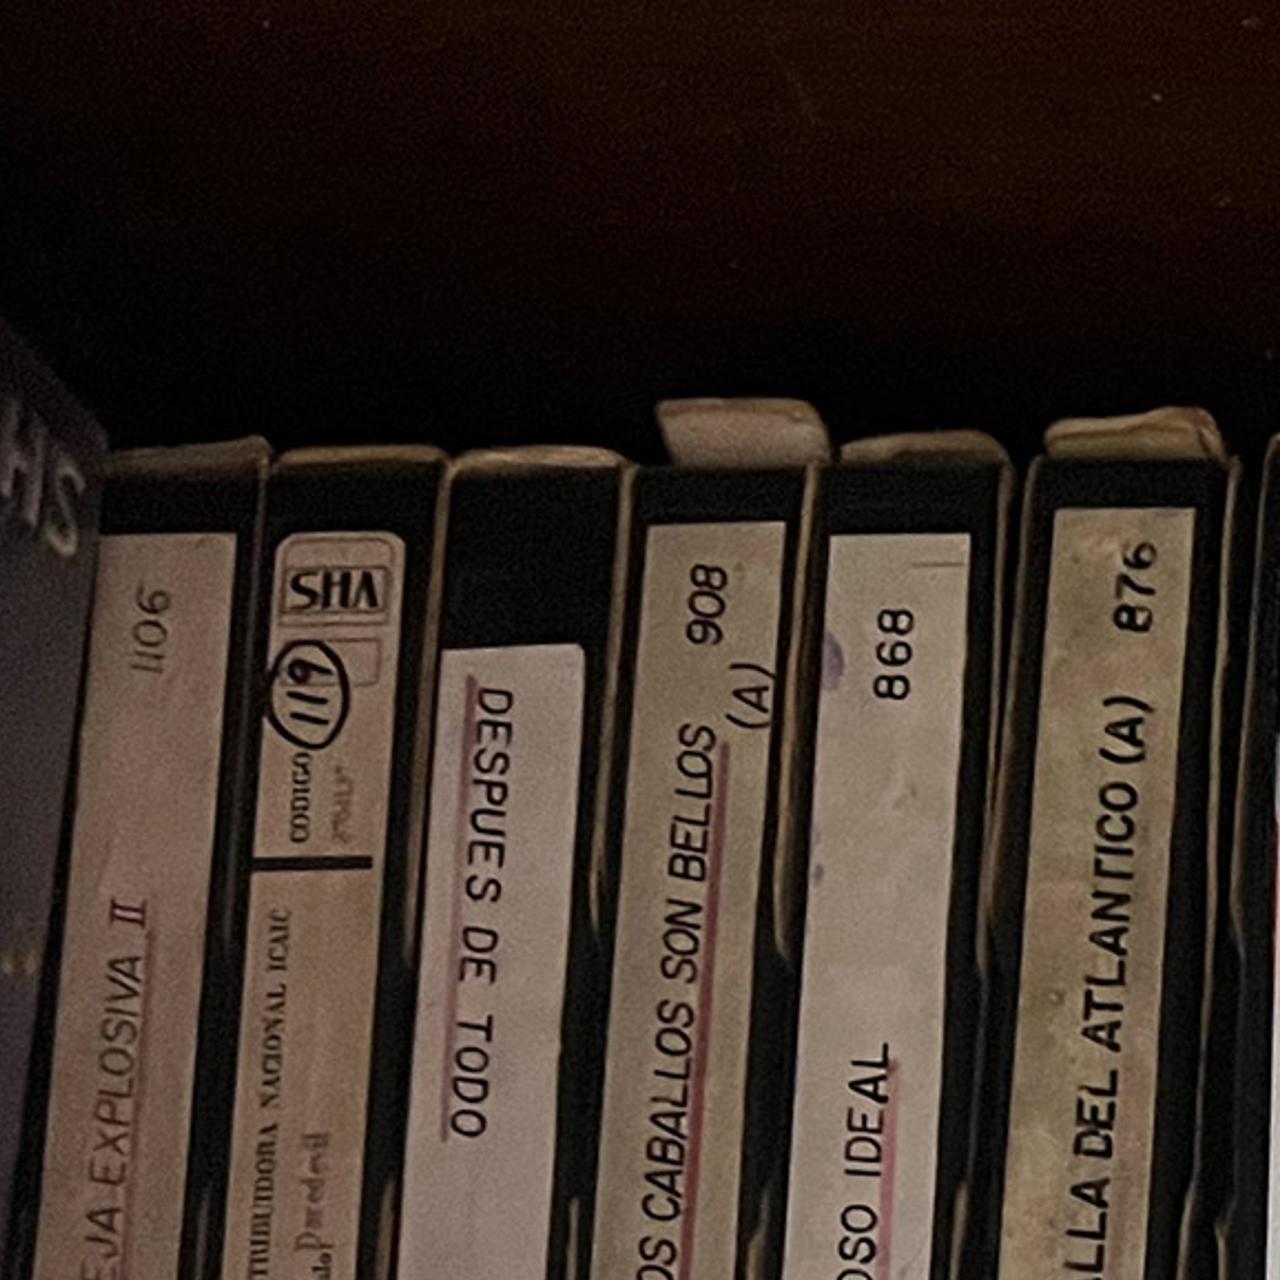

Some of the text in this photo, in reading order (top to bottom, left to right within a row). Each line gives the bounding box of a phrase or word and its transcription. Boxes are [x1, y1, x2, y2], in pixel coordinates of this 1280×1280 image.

[128, 587, 170, 676] 1106
[289, 569, 381, 610] VHS
[687, 563, 729, 646] 908
[1112, 541, 1158, 633] 876
[725, 662, 777, 730] (A)
[873, 607, 915, 701] 868
[1099, 695, 1157, 764] (A)
[289, 752, 313, 844] CODIGO
[668, 722, 718, 882] BELLOS
[265, 906, 295, 973] ICAIC
[449, 686, 515, 1140] DESPUES DE TODO
[660, 900, 704, 984] SON
[1080, 781, 1140, 1053] ATLANTICO
[89, 955, 142, 1187] EXPLOSIVA
[260, 980, 287, 1110] NACIONAL
[641, 999, 695, 1224] CABALLOS
[843, 1042, 891, 1179] IDEAL
[1073, 1068, 1119, 1161] DEL
